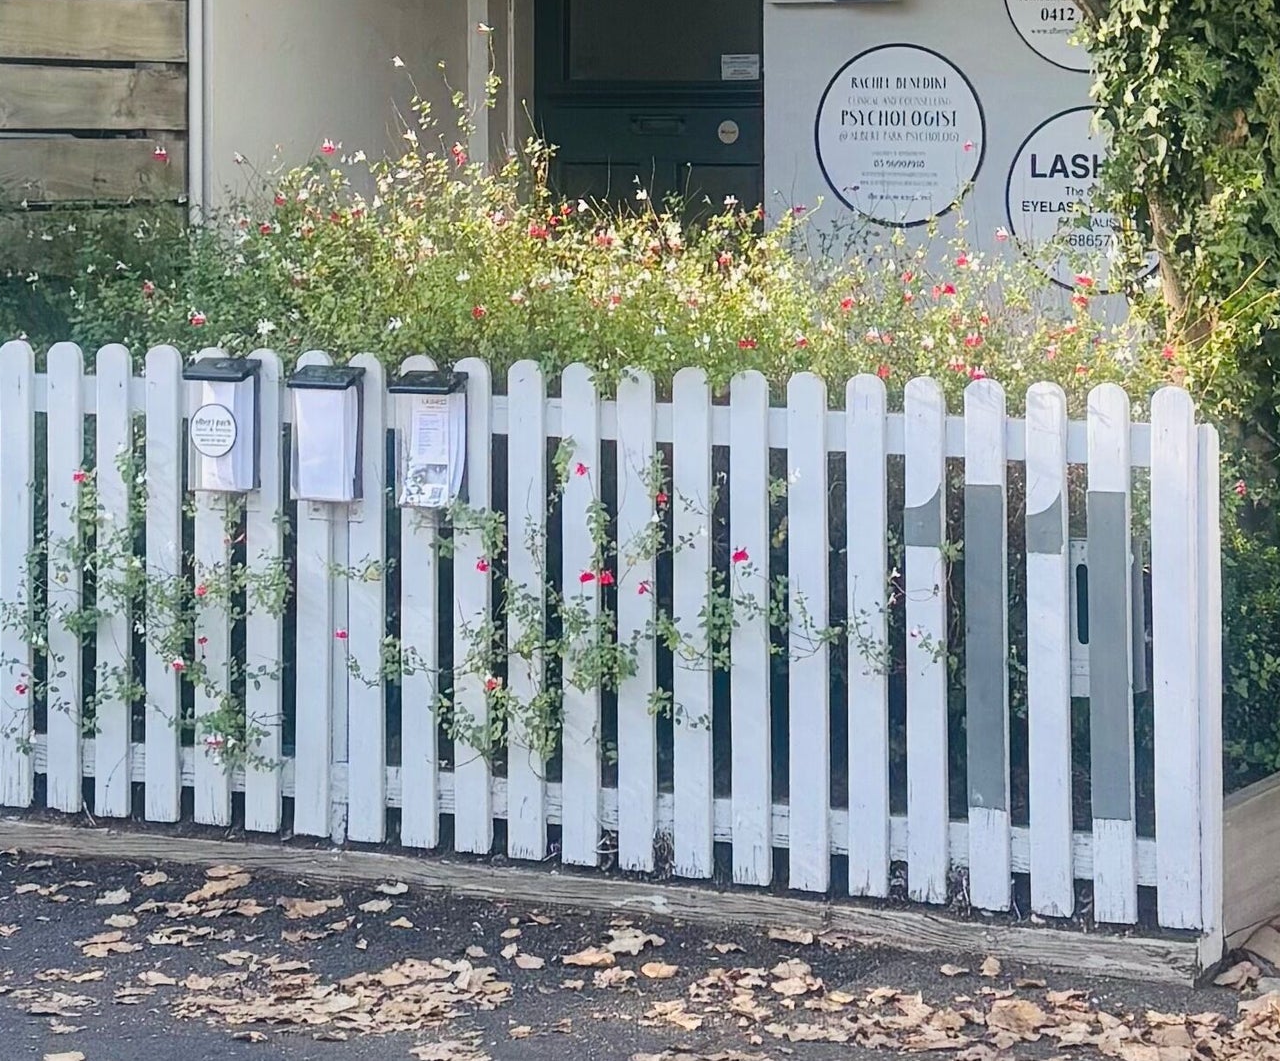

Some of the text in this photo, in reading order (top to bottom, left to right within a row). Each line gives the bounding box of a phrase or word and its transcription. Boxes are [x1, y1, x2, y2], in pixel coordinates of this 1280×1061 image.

[1041, 7, 1075, 21] 0412
[851, 76, 889, 89] RACHEL
[841, 109, 957, 127] PSYCHOLOGIST
[1030, 153, 1109, 179] LASH
[1022, 200, 1079, 213] EYELAS
